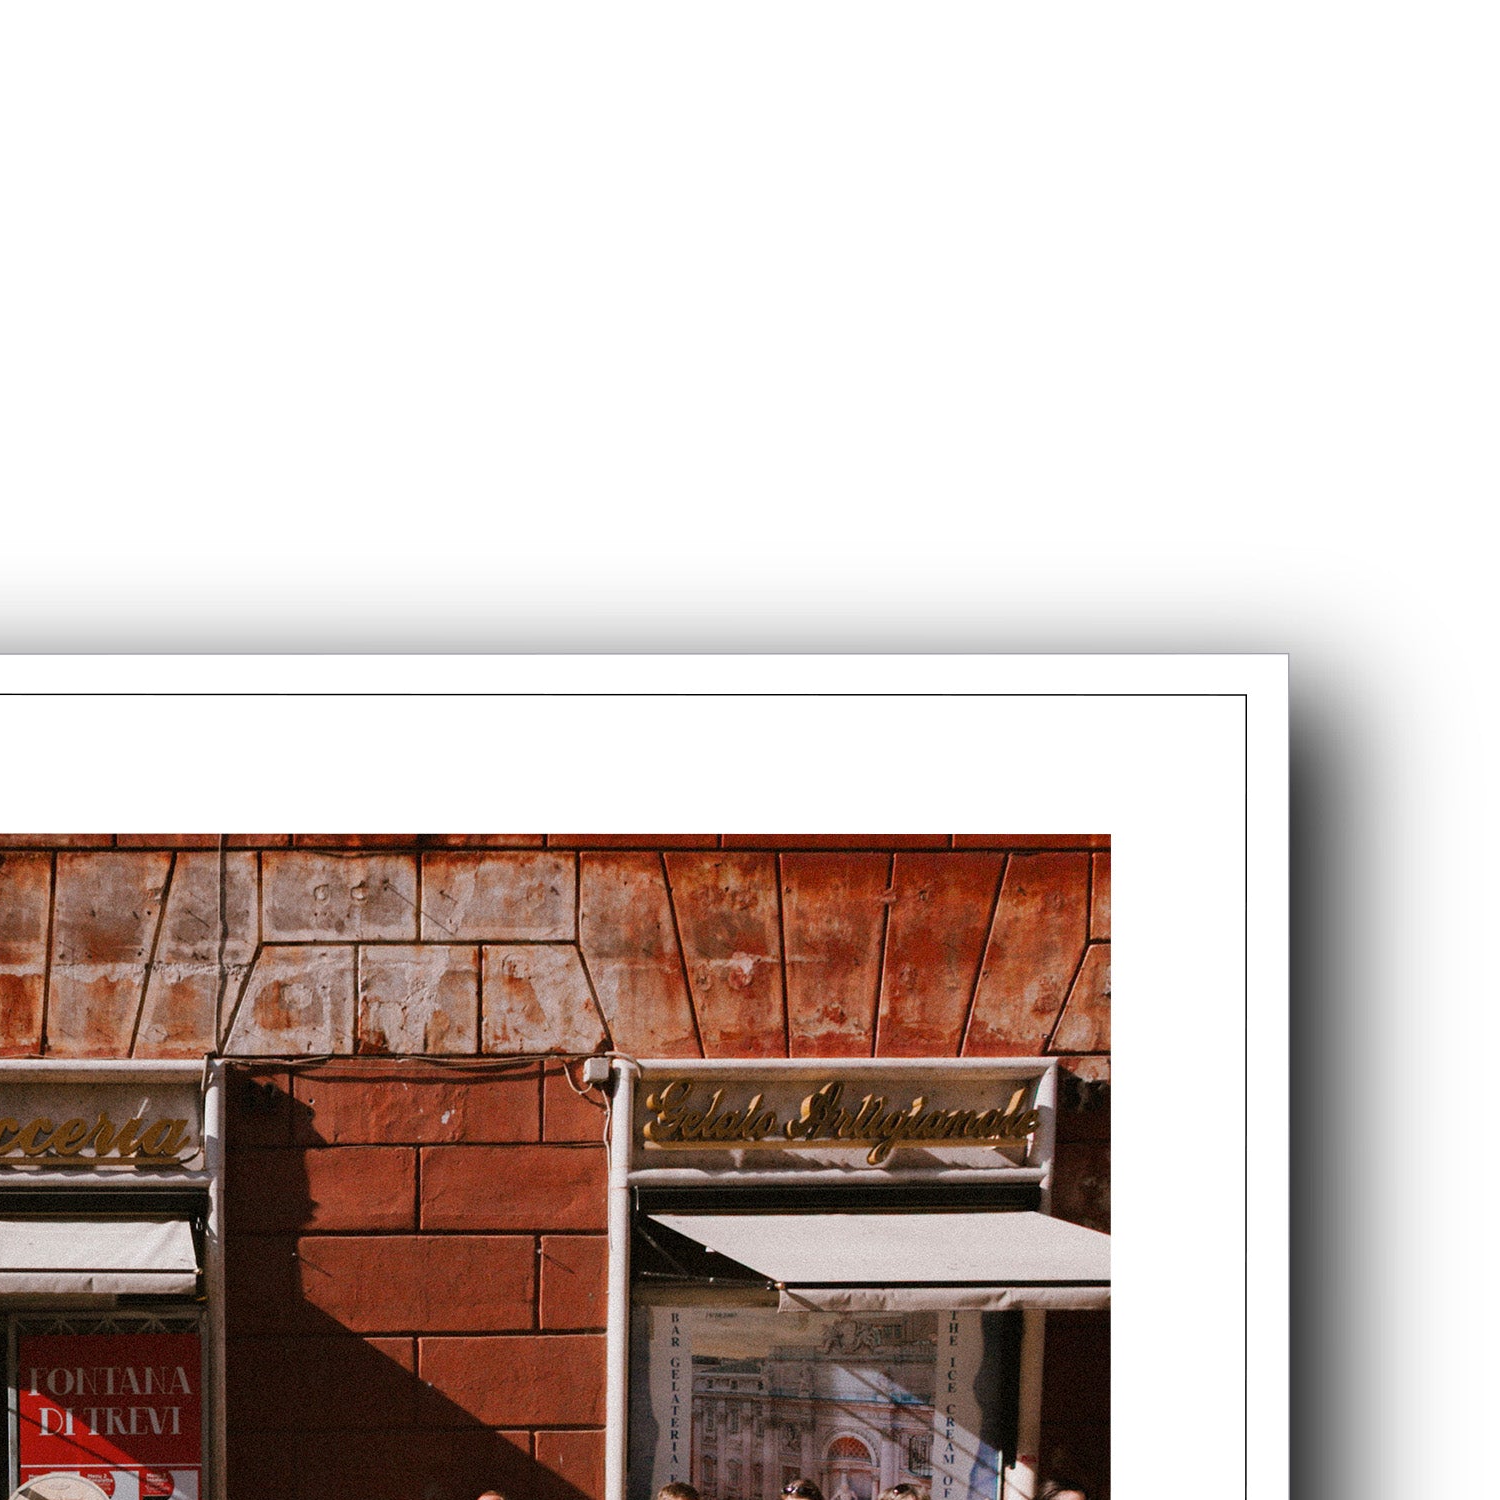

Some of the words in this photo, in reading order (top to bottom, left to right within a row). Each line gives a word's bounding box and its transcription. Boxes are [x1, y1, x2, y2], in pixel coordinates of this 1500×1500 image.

[643, 1078, 778, 1141] Gelato
[670, 1312, 680, 1347] BAR
[949, 1310, 959, 1347] THE
[28, 1365, 194, 1397] FONTANA
[947, 1356, 957, 1394] ICE
[39, 1407, 77, 1437] DI
[83, 1405, 183, 1436] TREVI
[669, 1356, 681, 1464] GELATERIA
[944, 1403, 956, 1465] CREAM
[942, 1475, 954, 1499] OF
